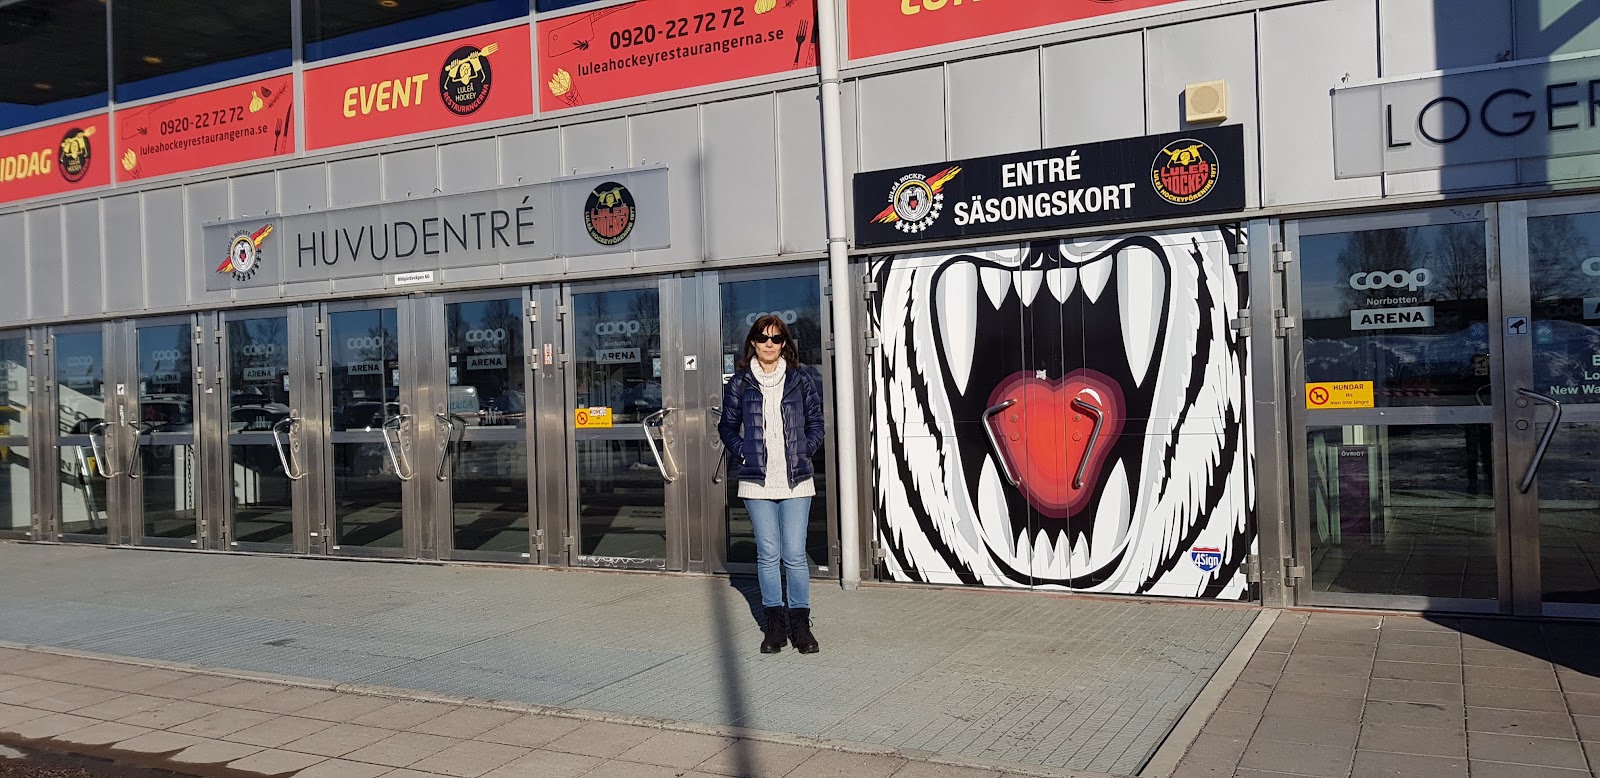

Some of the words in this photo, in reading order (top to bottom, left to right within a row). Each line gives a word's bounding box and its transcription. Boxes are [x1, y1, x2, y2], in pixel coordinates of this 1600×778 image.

[610, 18, 689, 49] 0920-22
[693, 12, 716, 34] 72
[721, 6, 745, 28] 72
[578, 29, 784, 76] luleahockeyrestaurangerna.se
[343, 73, 429, 118] EVENT
[457, 82, 474, 94] LULEÅ
[443, 84, 489, 113] RESTAURANGERNA
[455, 92, 477, 102] HOCKEY
[160, 113, 209, 135] 0920-22
[212, 109, 226, 126] 72
[230, 106, 244, 123] 72
[140, 123, 268, 156] luleahockeyrestaurangerna.se
[1002, 150, 1081, 188] ENTRÉ
[1161, 160, 1208, 177] LULEÅ
[888, 181, 900, 203] LULEÅ
[899, 173, 926, 183] HOCKEY
[1153, 169, 1164, 191] LULEÅ
[1160, 179, 1214, 202] HOCKEYFÖRENING
[1161, 172, 1208, 195] HOCKEY
[954, 183, 1136, 226] SÄSONGSKORT
[297, 195, 536, 268] HUVUDENTRÉ
[1349, 268, 1433, 292] coop
[1366, 296, 1417, 306] Norrbotten
[1361, 311, 1425, 325] ARENA
[465, 328, 506, 345] coop
[595, 320, 640, 337] coop
[243, 344, 275, 358] coop
[347, 336, 383, 351] coop
[152, 349, 180, 362] coop
[471, 357, 503, 367] ARENA
[601, 351, 636, 361] ARENA
[247, 370, 272, 378] ARENA
[351, 363, 380, 372] ARENA
[1333, 383, 1364, 391] HUNDAR
[1550, 385, 1579, 395] New
[1194, 553, 1219, 569] 4Sign
